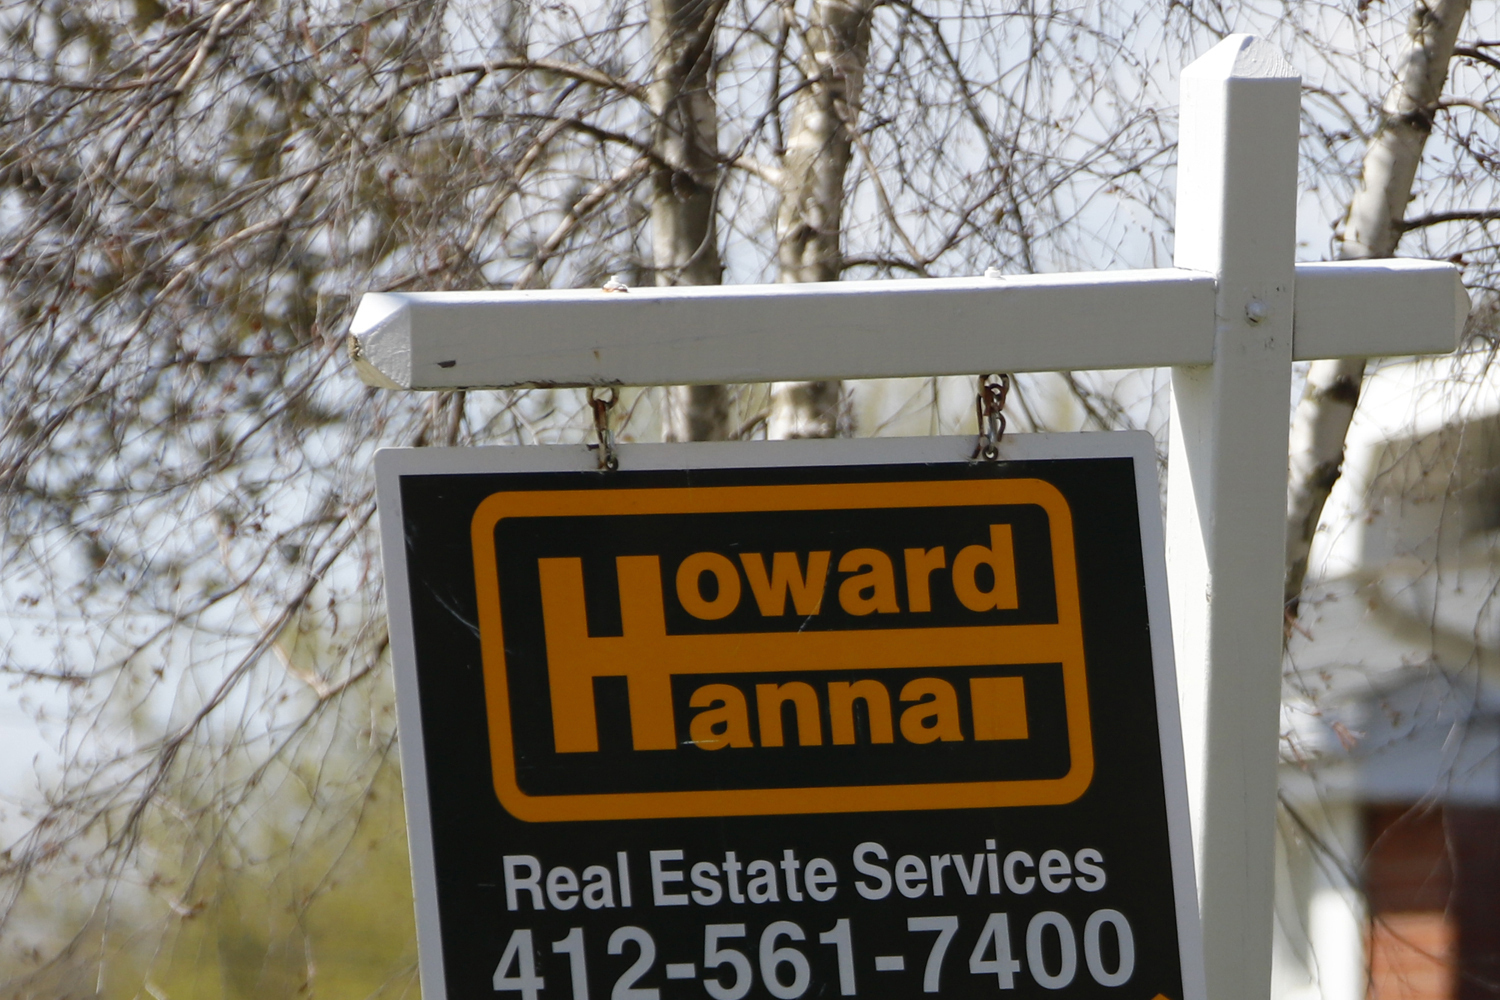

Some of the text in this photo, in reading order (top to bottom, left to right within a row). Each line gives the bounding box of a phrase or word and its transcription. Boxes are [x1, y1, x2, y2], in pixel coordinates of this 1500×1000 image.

[537, 523, 1020, 664] Howard
[541, 637, 965, 754] Hanna
[503, 839, 1107, 911] Real Estate Services
